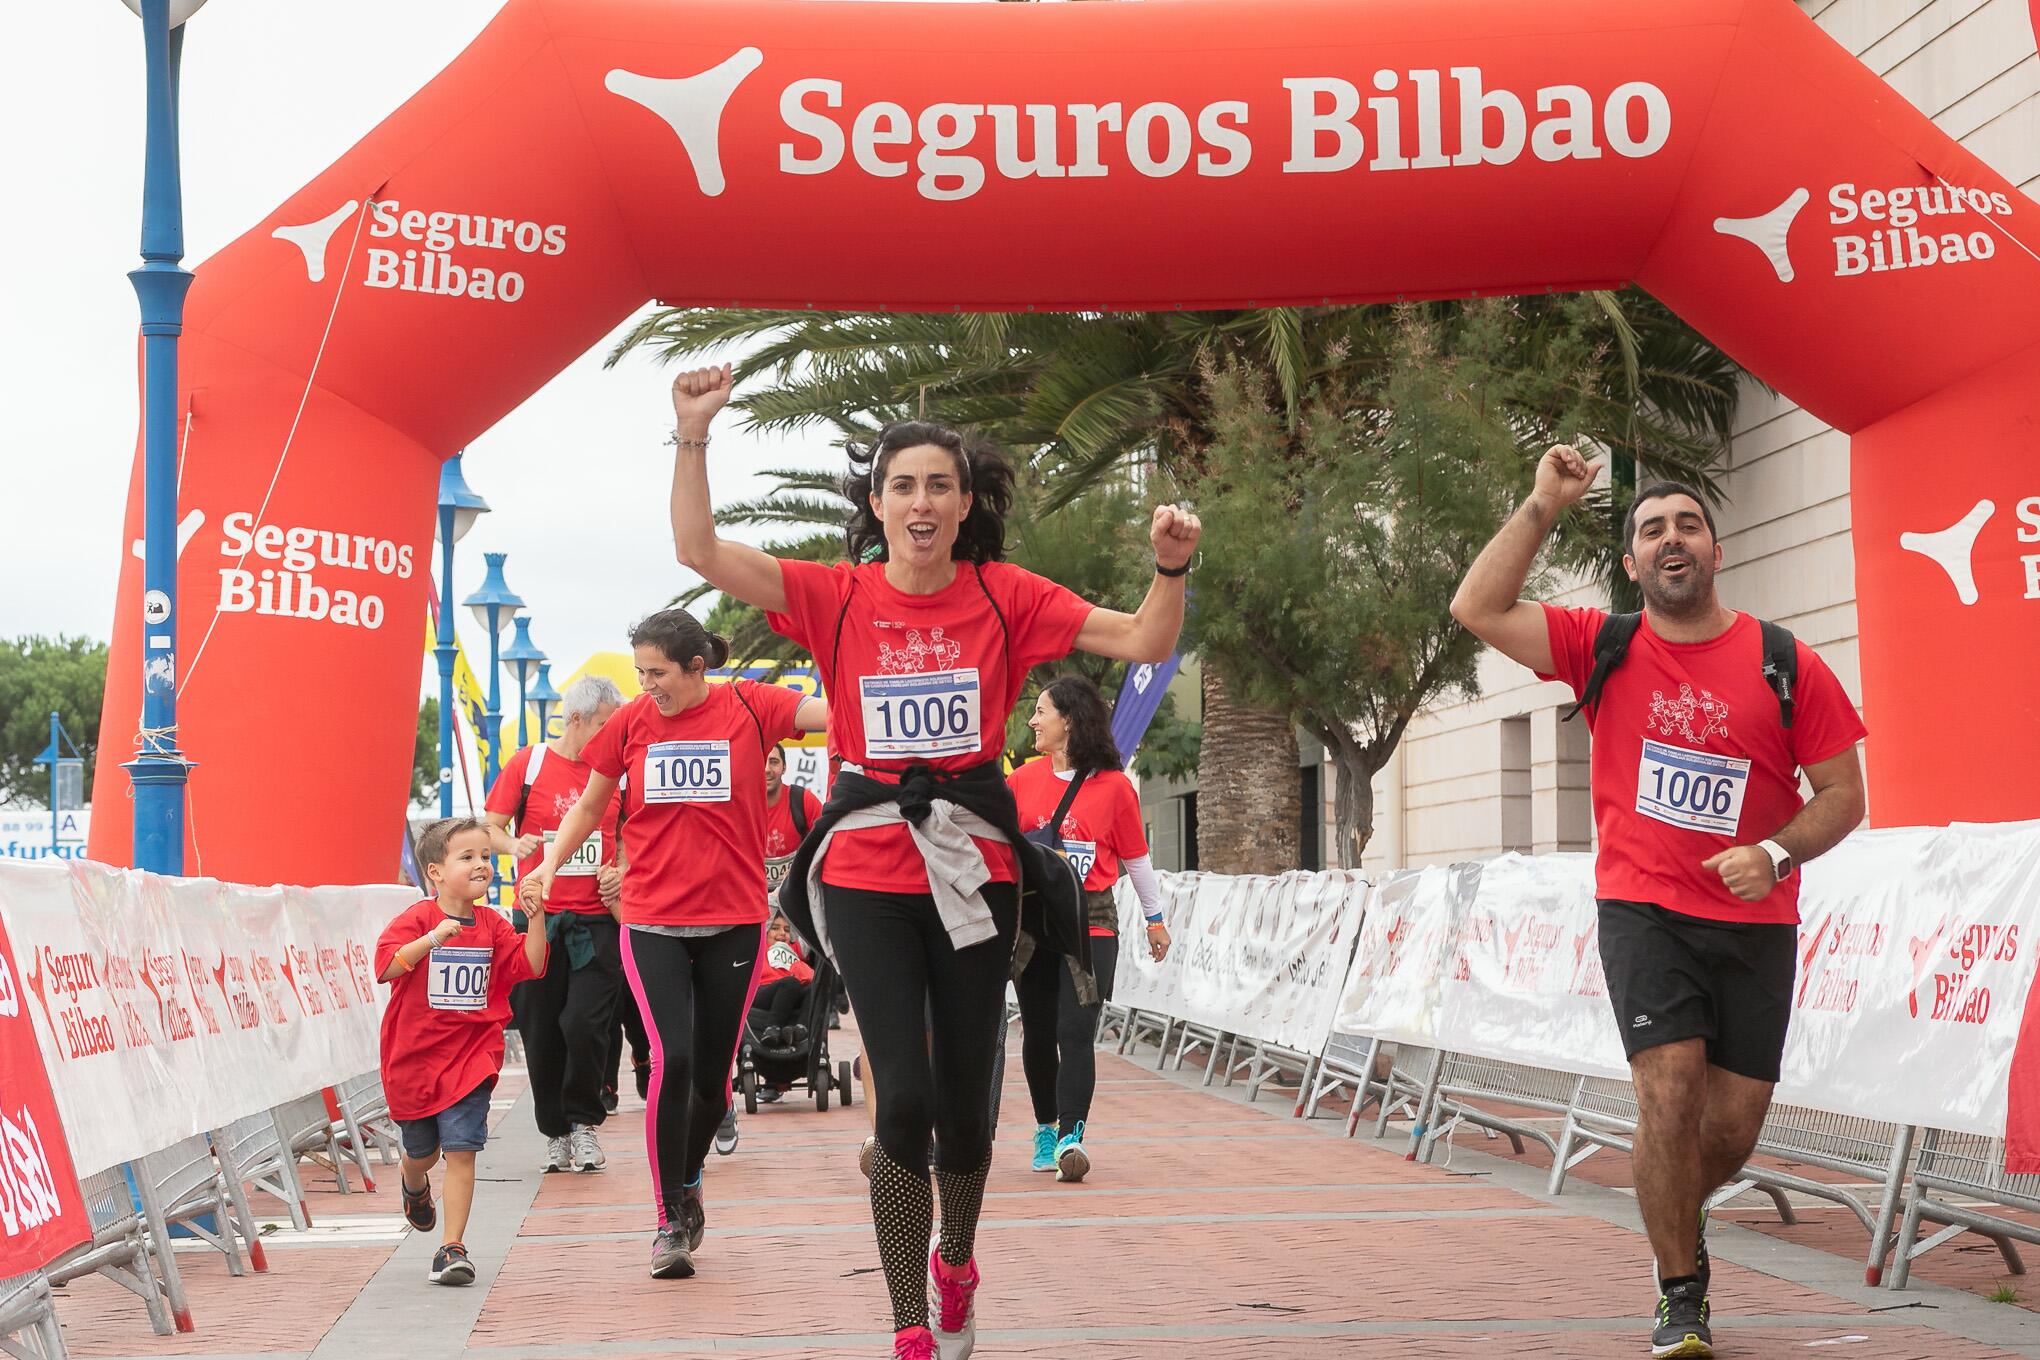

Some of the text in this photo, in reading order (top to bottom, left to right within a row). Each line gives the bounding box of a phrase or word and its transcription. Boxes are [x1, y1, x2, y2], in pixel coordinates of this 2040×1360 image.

[779, 66, 1672, 201] Seguros Bilbao
[368, 199, 567, 256] Seguros
[1828, 183, 2014, 228] Seguros
[363, 248, 525, 303] Bilbao
[1832, 227, 1995, 277] Bilbao
[219, 511, 413, 579] Seguros
[216, 567, 385, 630] Bilbao
[876, 694, 969, 739] 1006
[655, 758, 722, 787] 1005
[1652, 766, 1734, 815] 1006
[564, 844, 597, 864] 40
[765, 862, 793, 880] 204
[772, 949, 798, 965] 204
[60, 1006, 116, 1059] Bilbao
